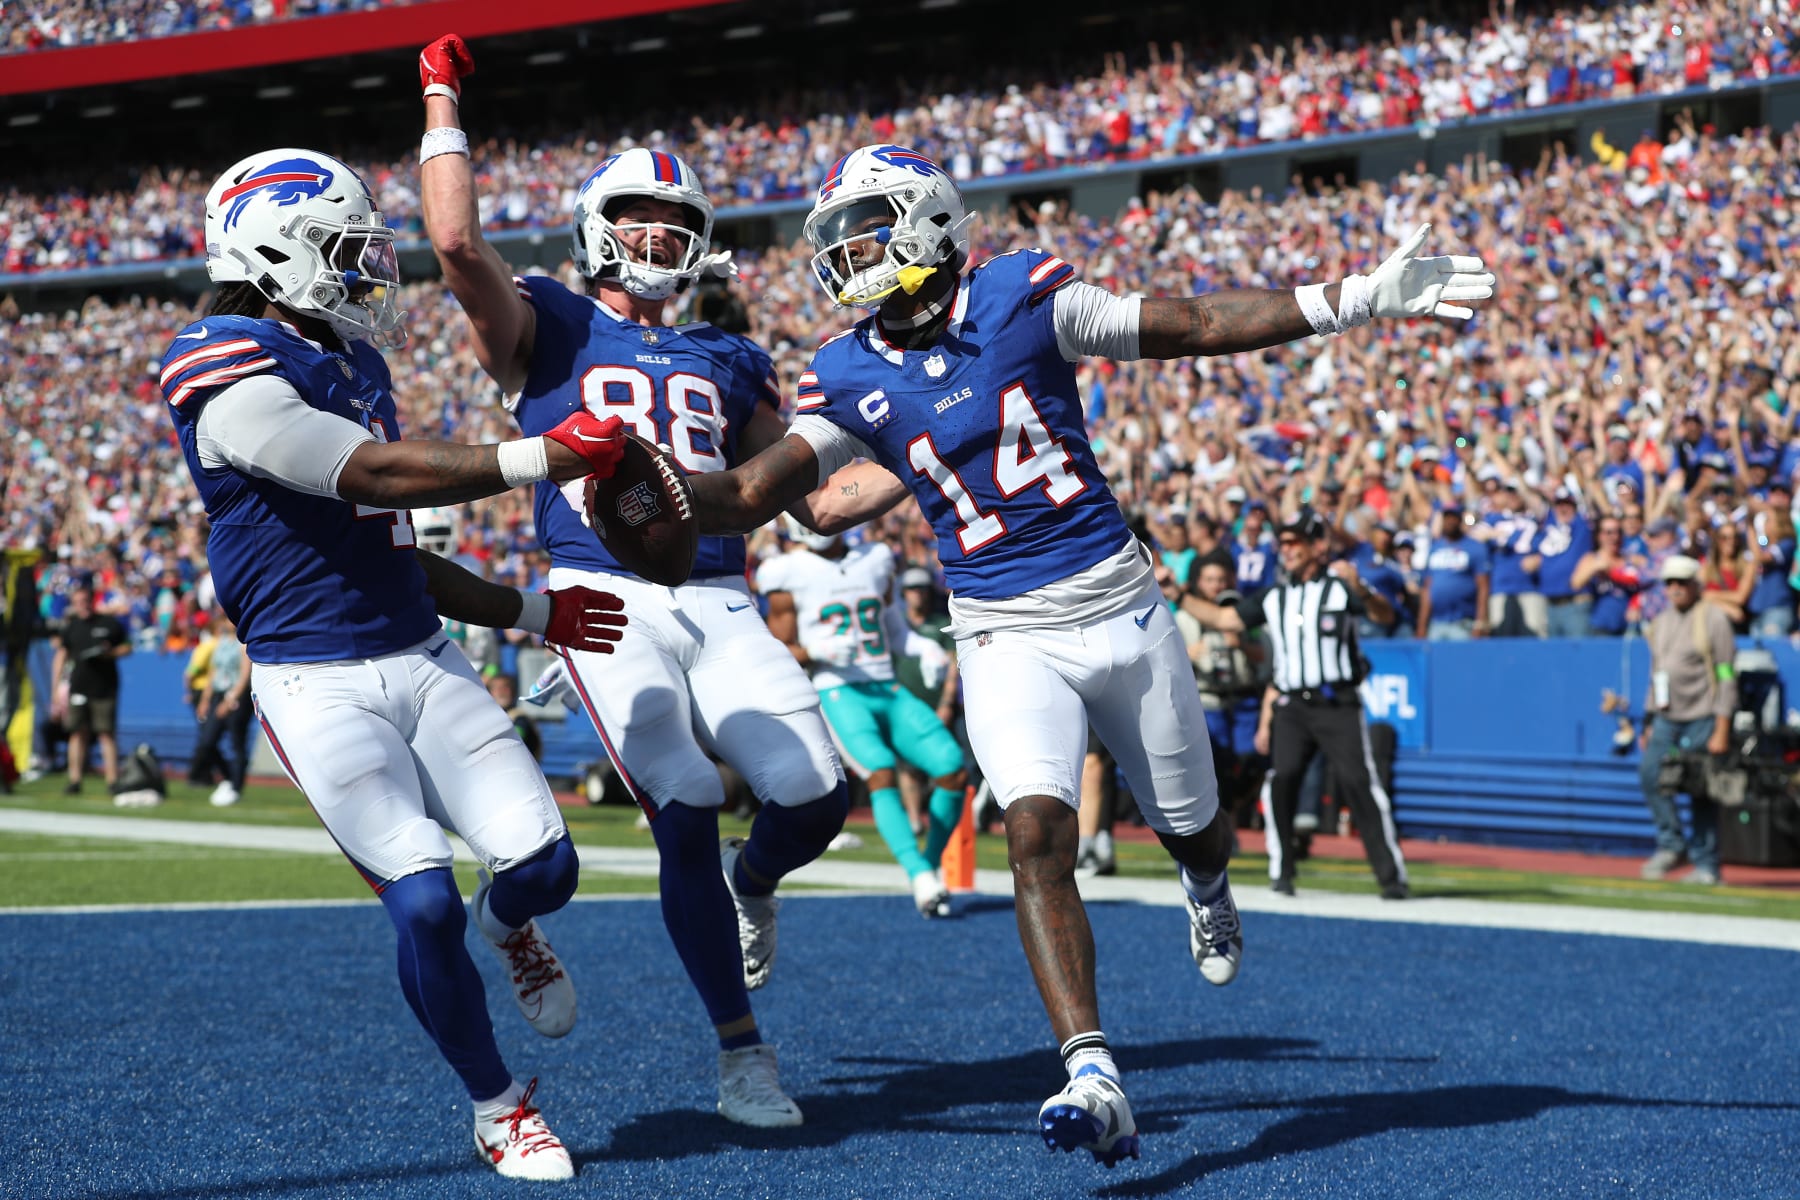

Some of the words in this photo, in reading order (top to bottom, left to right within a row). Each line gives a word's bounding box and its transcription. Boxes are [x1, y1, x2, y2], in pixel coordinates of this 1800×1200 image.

[635, 354, 671, 365] BILLS
[858, 389, 889, 423] C
[933, 387, 973, 414] BILLS
[579, 364, 728, 474] 88
[906, 380, 1088, 555] 14
[620, 491, 647, 523] NFL
[1237, 552, 1265, 581] 17
[1356, 674, 1417, 718] NFL
